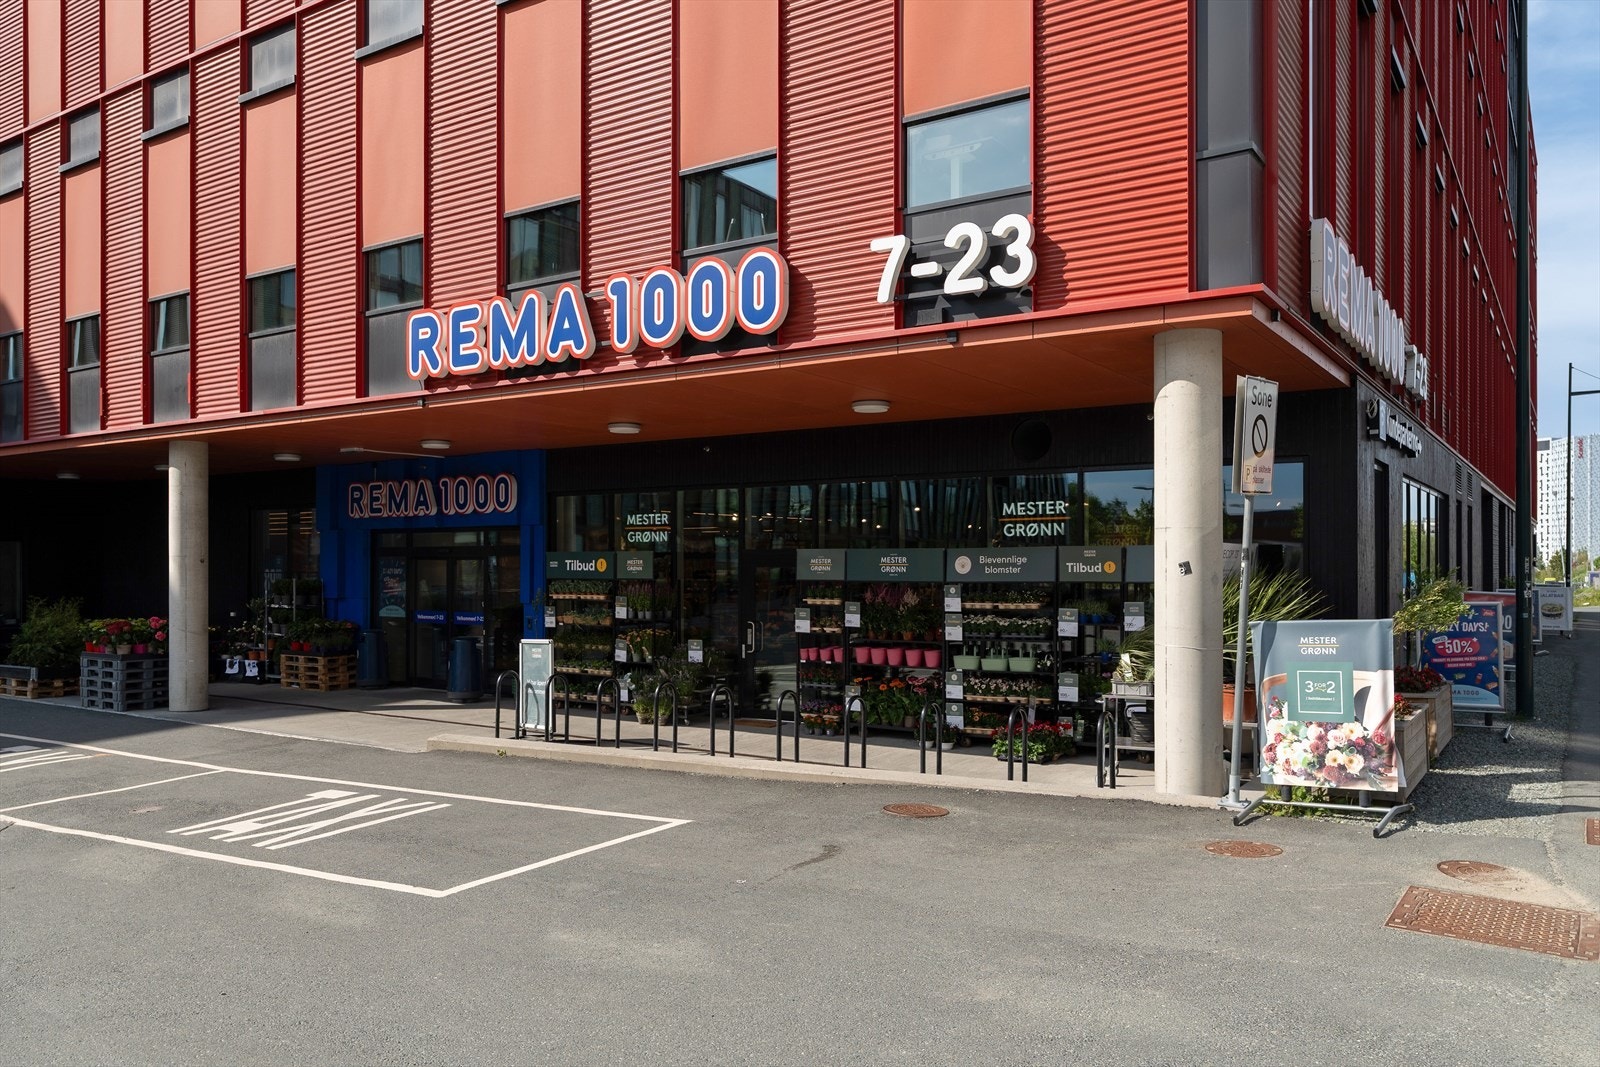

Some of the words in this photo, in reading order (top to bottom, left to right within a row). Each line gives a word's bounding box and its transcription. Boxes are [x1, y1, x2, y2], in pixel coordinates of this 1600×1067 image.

[870, 213, 1037, 305] 7-23
[1322, 216, 1375, 359] REMA
[1376, 289, 1405, 386] 1000
[407, 283, 594, 381] REMA
[605, 246, 788, 353] 1000
[1251, 385, 1273, 408] Sone
[348, 478, 437, 520] REMA
[438, 471, 518, 516] 1000
[1002, 500, 1067, 516] MESTER
[626, 512, 669, 526] MESTER
[627, 530, 669, 543] GRØNN
[1003, 522, 1066, 537] GRØNN
[565, 560, 595, 571] Tilbud
[979, 555, 1028, 565] Bievennlige
[984, 566, 1021, 574] blomster
[1066, 562, 1102, 573] Tilbud
[1462, 622, 1488, 632] DAYS!
[1300, 647, 1336, 655] GRØNN
[1438, 640, 1473, 654] -50%
[1305, 680, 1314, 693] 3
[1326, 680, 1336, 694] 2
[164, 789, 453, 851] TAXI
